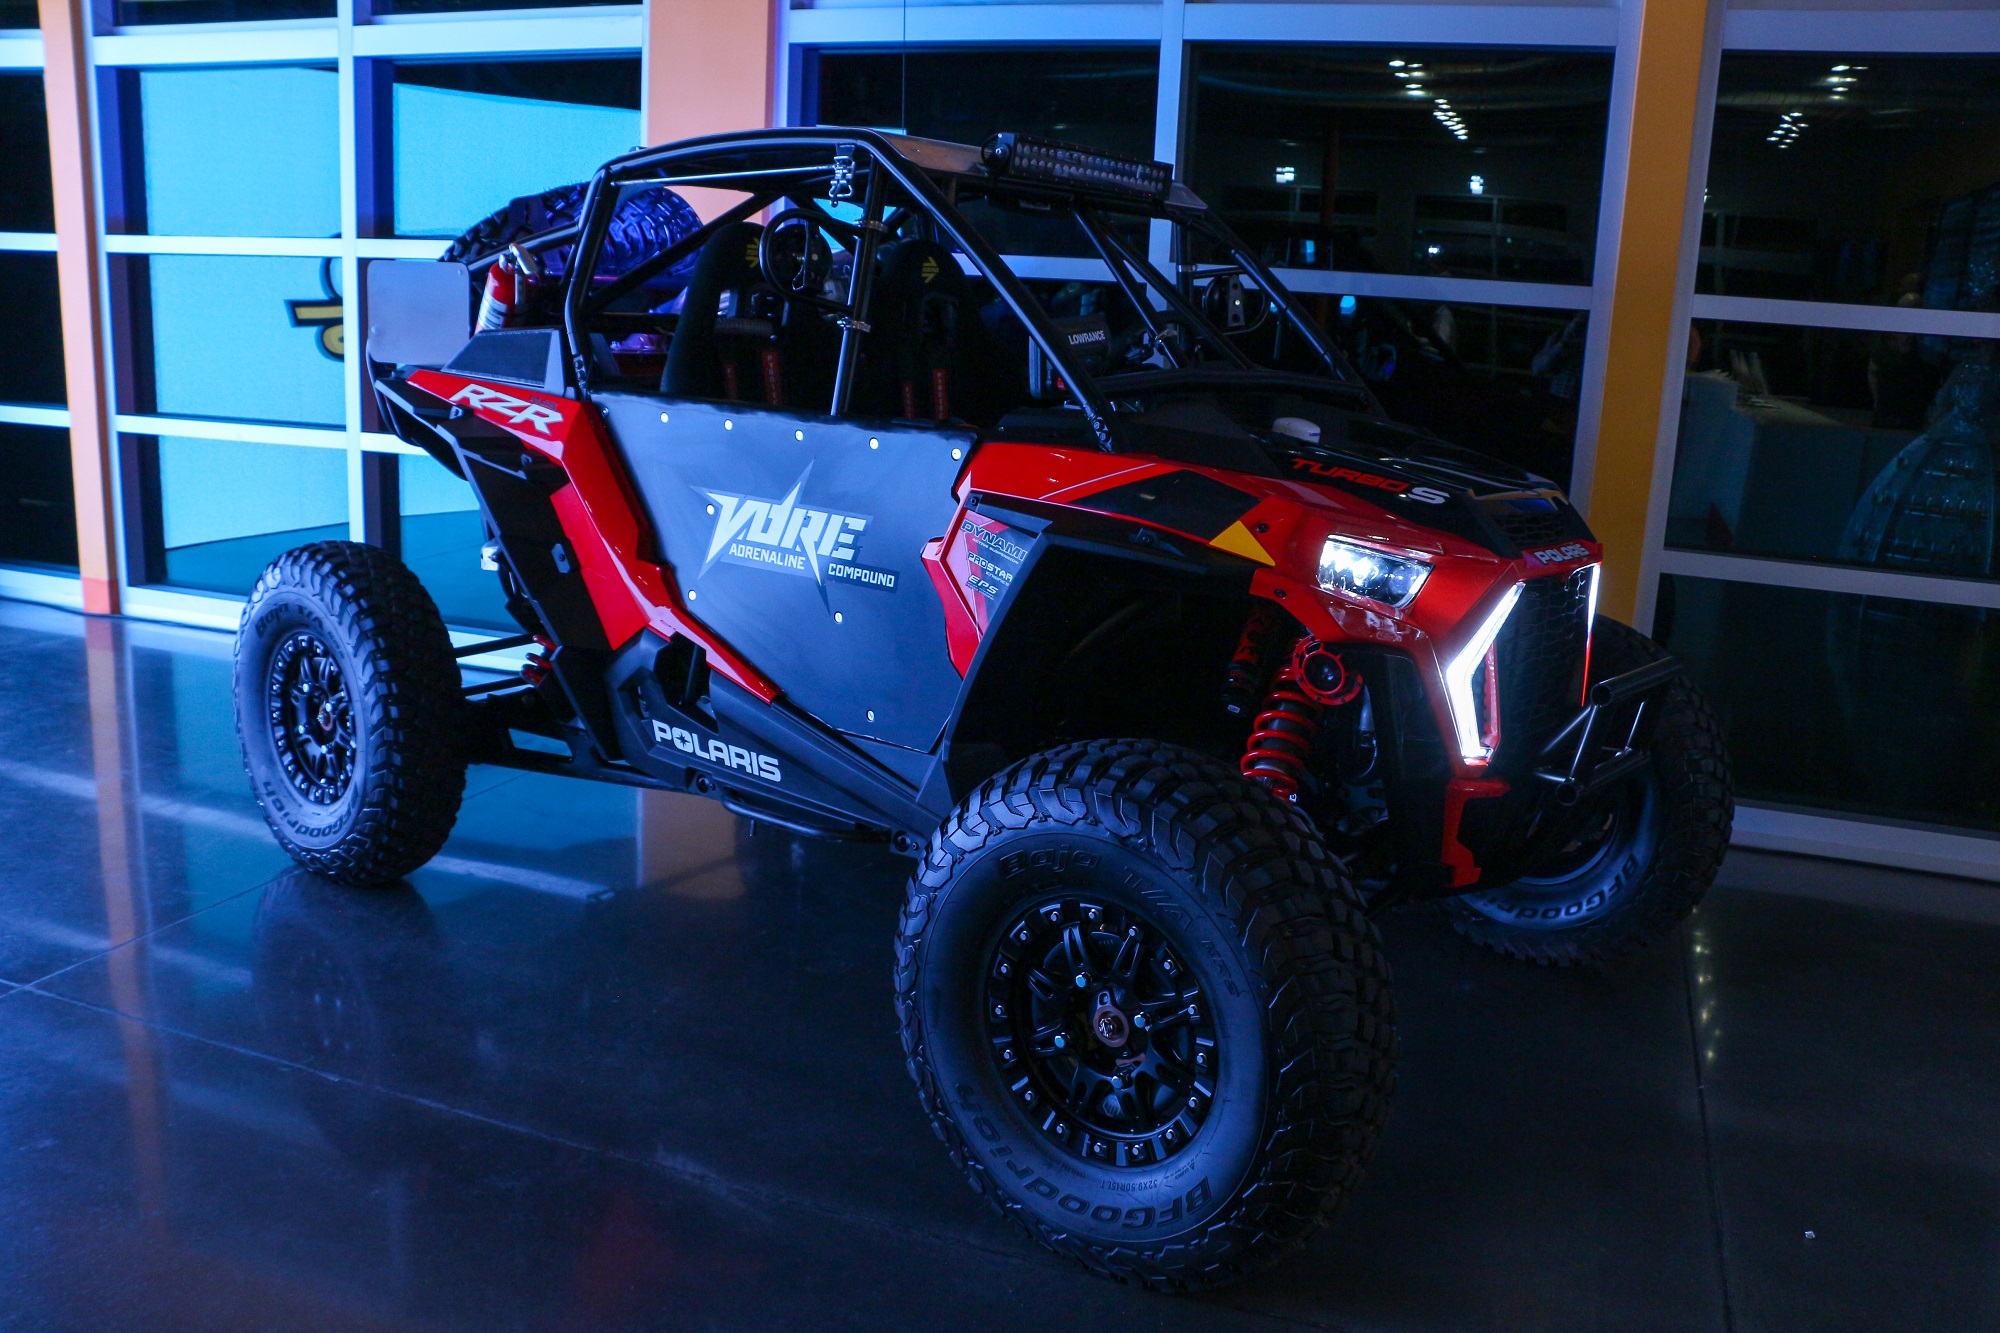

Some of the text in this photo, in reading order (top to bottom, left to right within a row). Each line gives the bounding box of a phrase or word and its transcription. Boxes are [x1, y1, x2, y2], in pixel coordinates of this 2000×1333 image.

[1067, 330, 1106, 345] LOWRANCE
[449, 383, 564, 434] RZR
[1292, 457, 1450, 505] TURBO S
[728, 543, 806, 570] ADRENALINE
[960, 519, 1028, 562] DYNAMI
[1533, 543, 1590, 565] POLARIS
[828, 563, 895, 587] COMPOUND
[968, 551, 1013, 582] PROSTAR
[968, 575, 998, 595] EPS
[652, 719, 781, 783] POLARIS
[1000, 844, 1101, 880] Baja
[956, 1083, 1212, 1230] BFGoodrich
